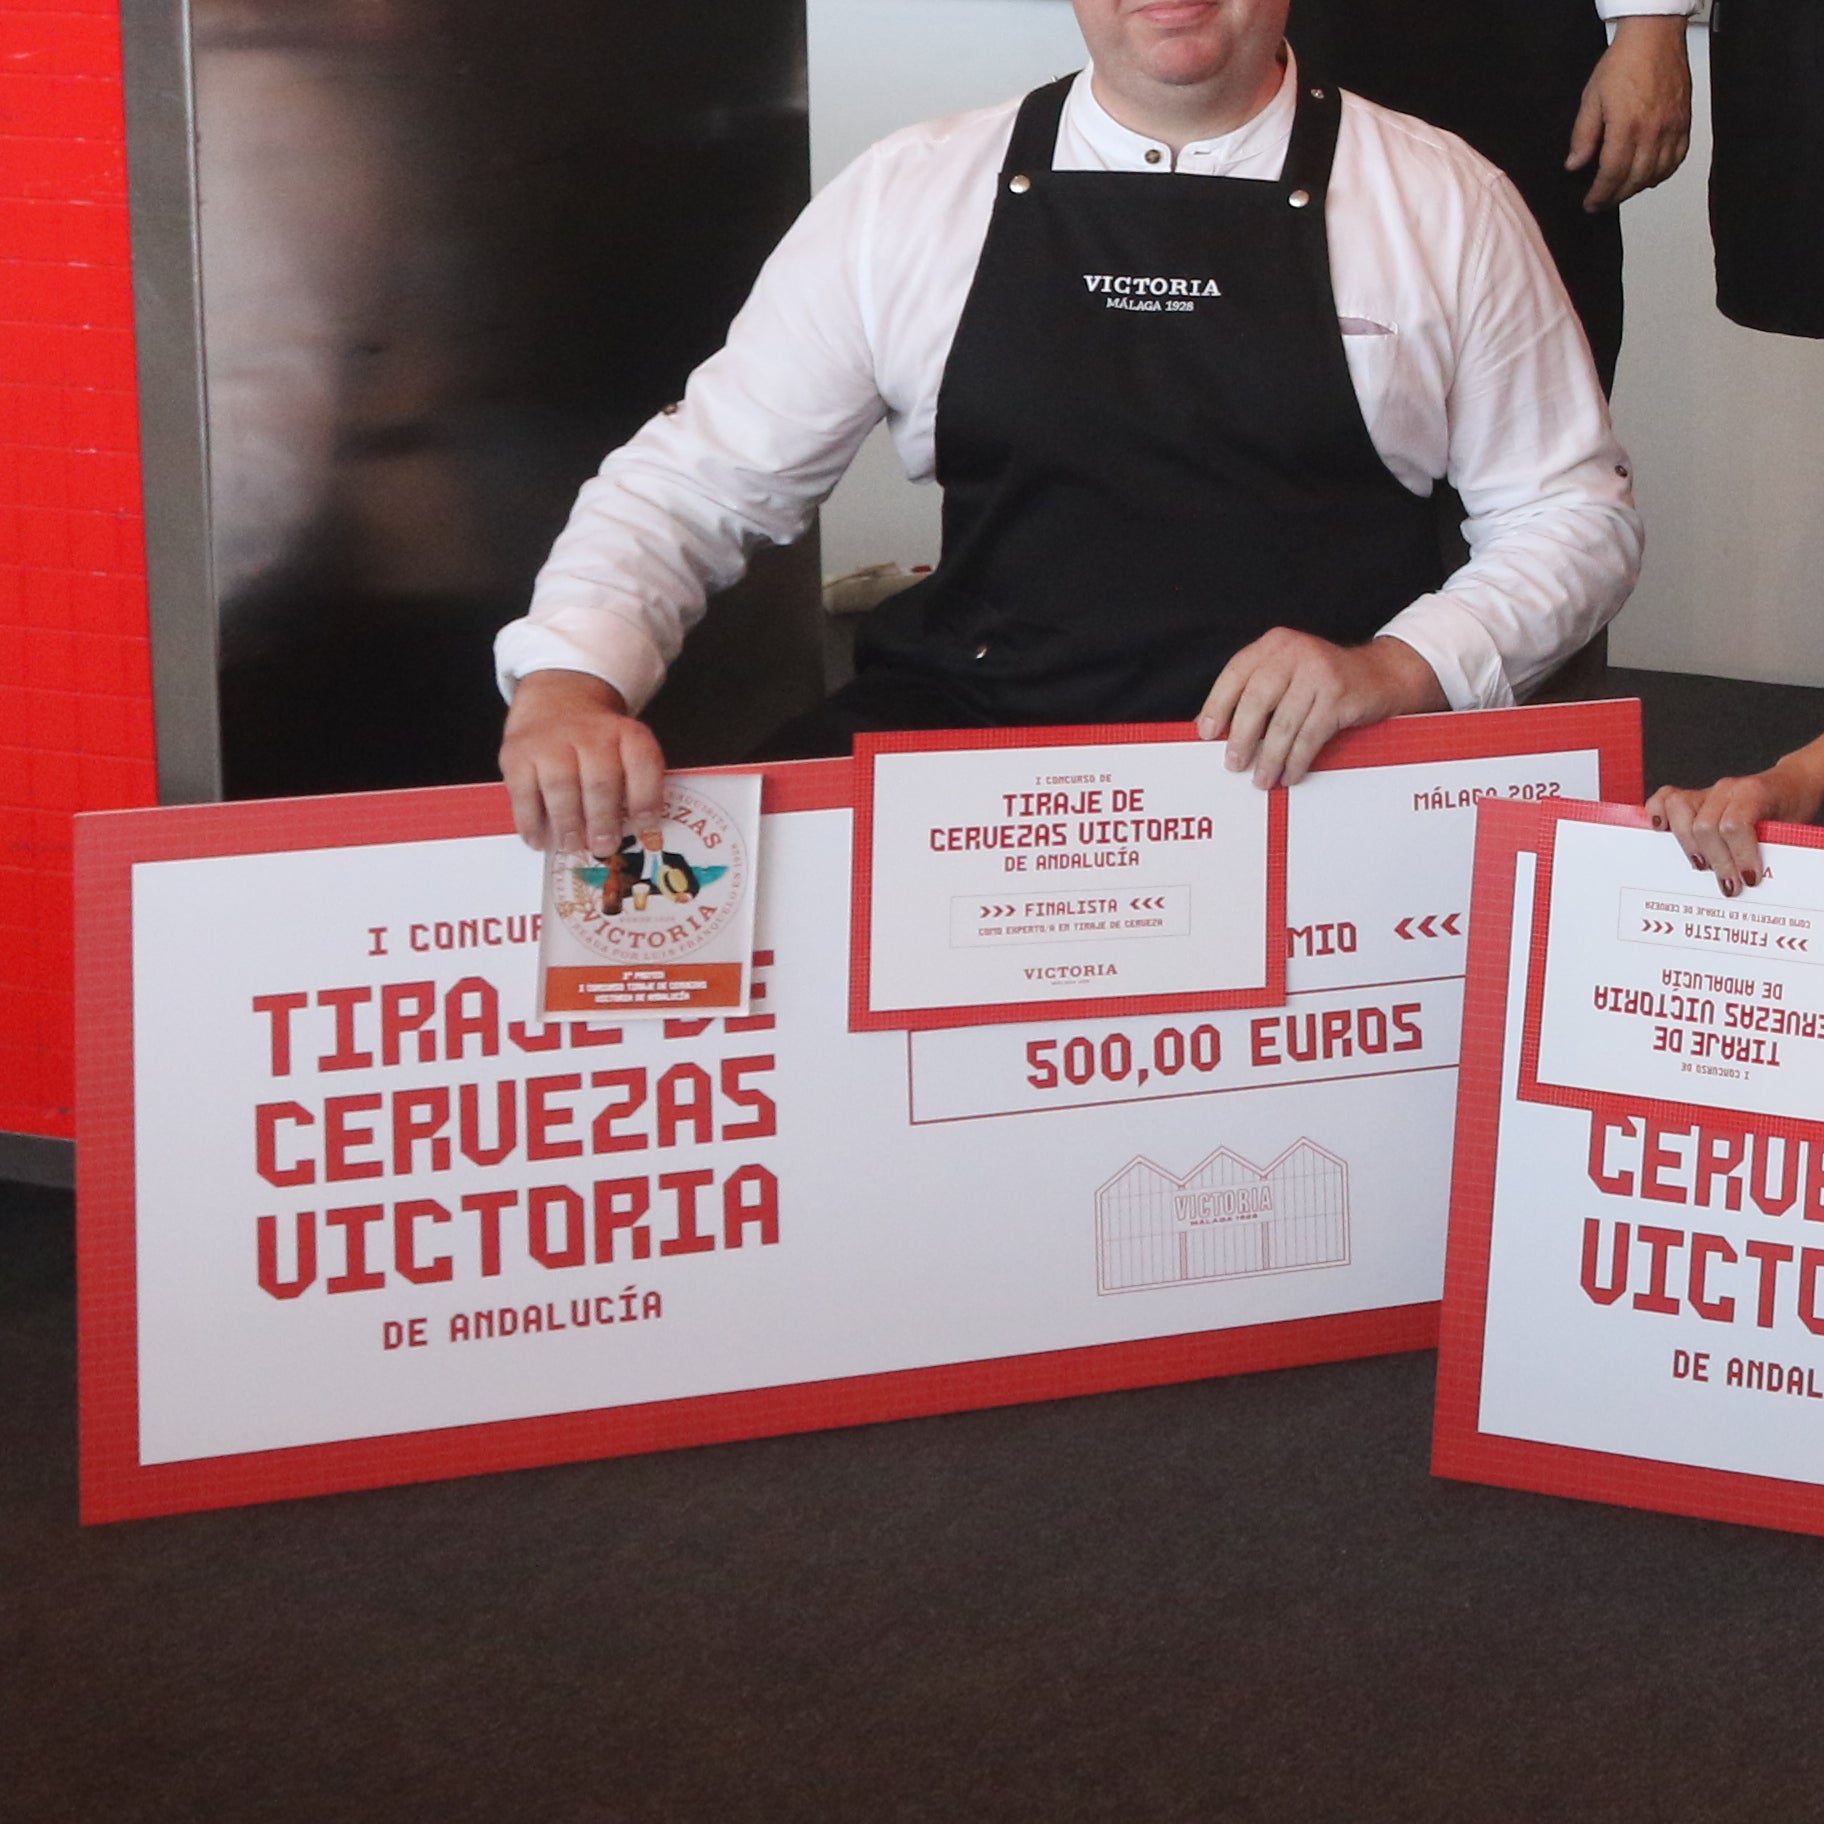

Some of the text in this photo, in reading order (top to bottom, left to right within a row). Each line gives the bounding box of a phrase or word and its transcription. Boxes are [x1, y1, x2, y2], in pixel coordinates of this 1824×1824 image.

[1083, 275, 1221, 296] VICTORIA
[1107, 298, 1194, 311] MÁLAGA 1928
[1002, 788, 1144, 817] TIRAJE DE
[930, 816, 1213, 851] CERVEZAS VICTORIA
[1004, 846, 1139, 871] DE ANDALUCÍA
[1024, 899, 1118, 916] FINALISTA
[368, 927, 388, 956] I
[583, 904, 718, 950] VICTORIA
[1683, 922, 1768, 946] FINALISTA
[1023, 963, 1118, 980] VICTORIA
[1661, 968, 1782, 999] DE ANDALUCÍA
[1592, 984, 1714, 1024] VICTORIA
[1026, 1003, 1422, 1090] 500,00 EUROS
[1652, 1025, 1781, 1066] TIRAJE DE
[255, 1054, 777, 1188] CERVEZAS
[1175, 1186, 1272, 1220] VICTORIA
[257, 1164, 779, 1301] VICTORIA
[383, 1286, 663, 1351] DE ANDALUCÍA
[1673, 1350, 1709, 1382] DE
